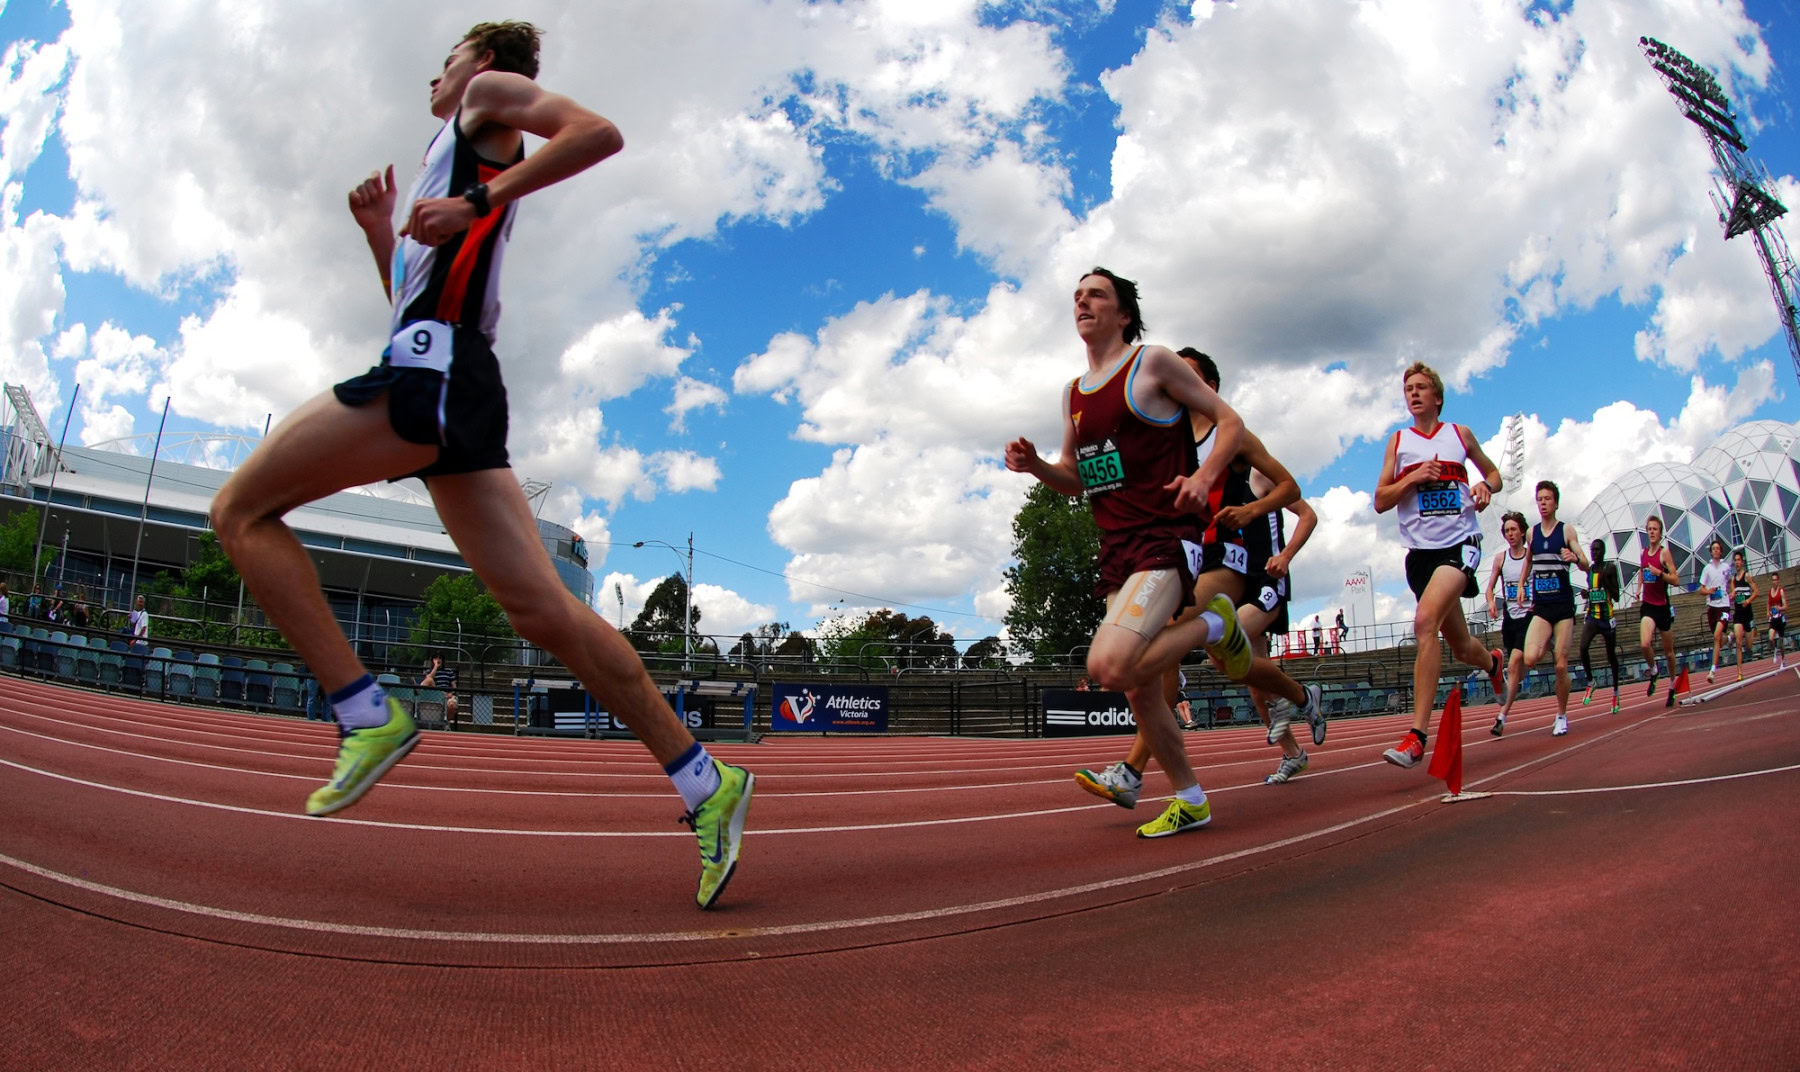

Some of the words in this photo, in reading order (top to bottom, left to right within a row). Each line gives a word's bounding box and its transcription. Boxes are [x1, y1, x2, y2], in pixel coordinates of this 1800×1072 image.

[412, 330, 431, 355] 9
[1422, 492, 1456, 508] 6562
[1231, 549, 1245, 567] 14
[1469, 551, 1476, 563] 7
[1263, 592, 1273, 601] 8
[825, 695, 881, 710] Athletics
[839, 710, 868, 718] Victoria
[1088, 707, 1137, 726] adid
